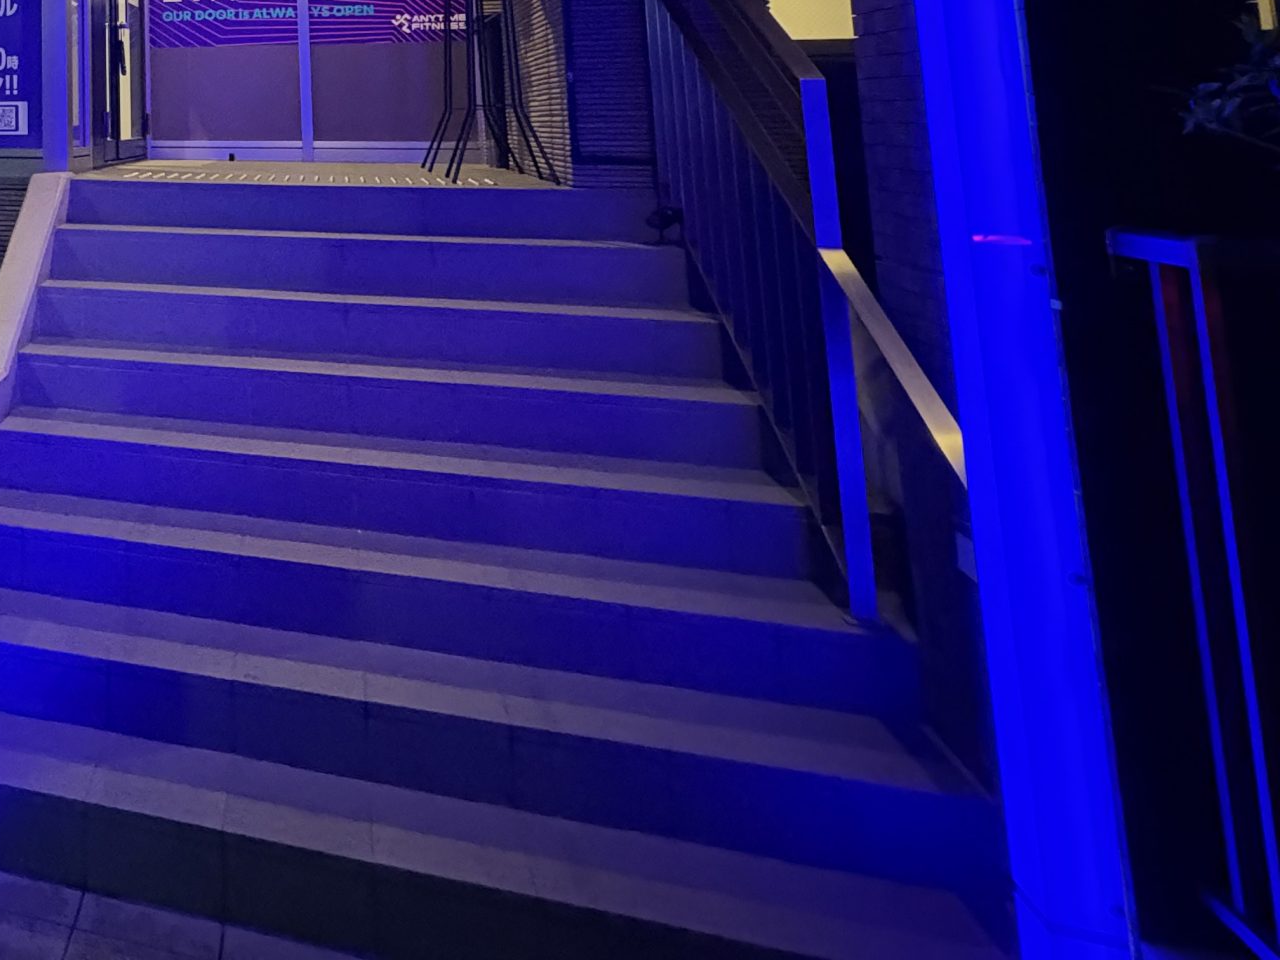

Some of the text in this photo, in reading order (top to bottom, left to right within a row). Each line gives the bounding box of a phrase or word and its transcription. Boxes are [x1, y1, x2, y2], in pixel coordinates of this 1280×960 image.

[162, 10, 192, 22] OUR
[195, 8, 236, 21] DOOR
[411, 13, 467, 22] ANYTME
